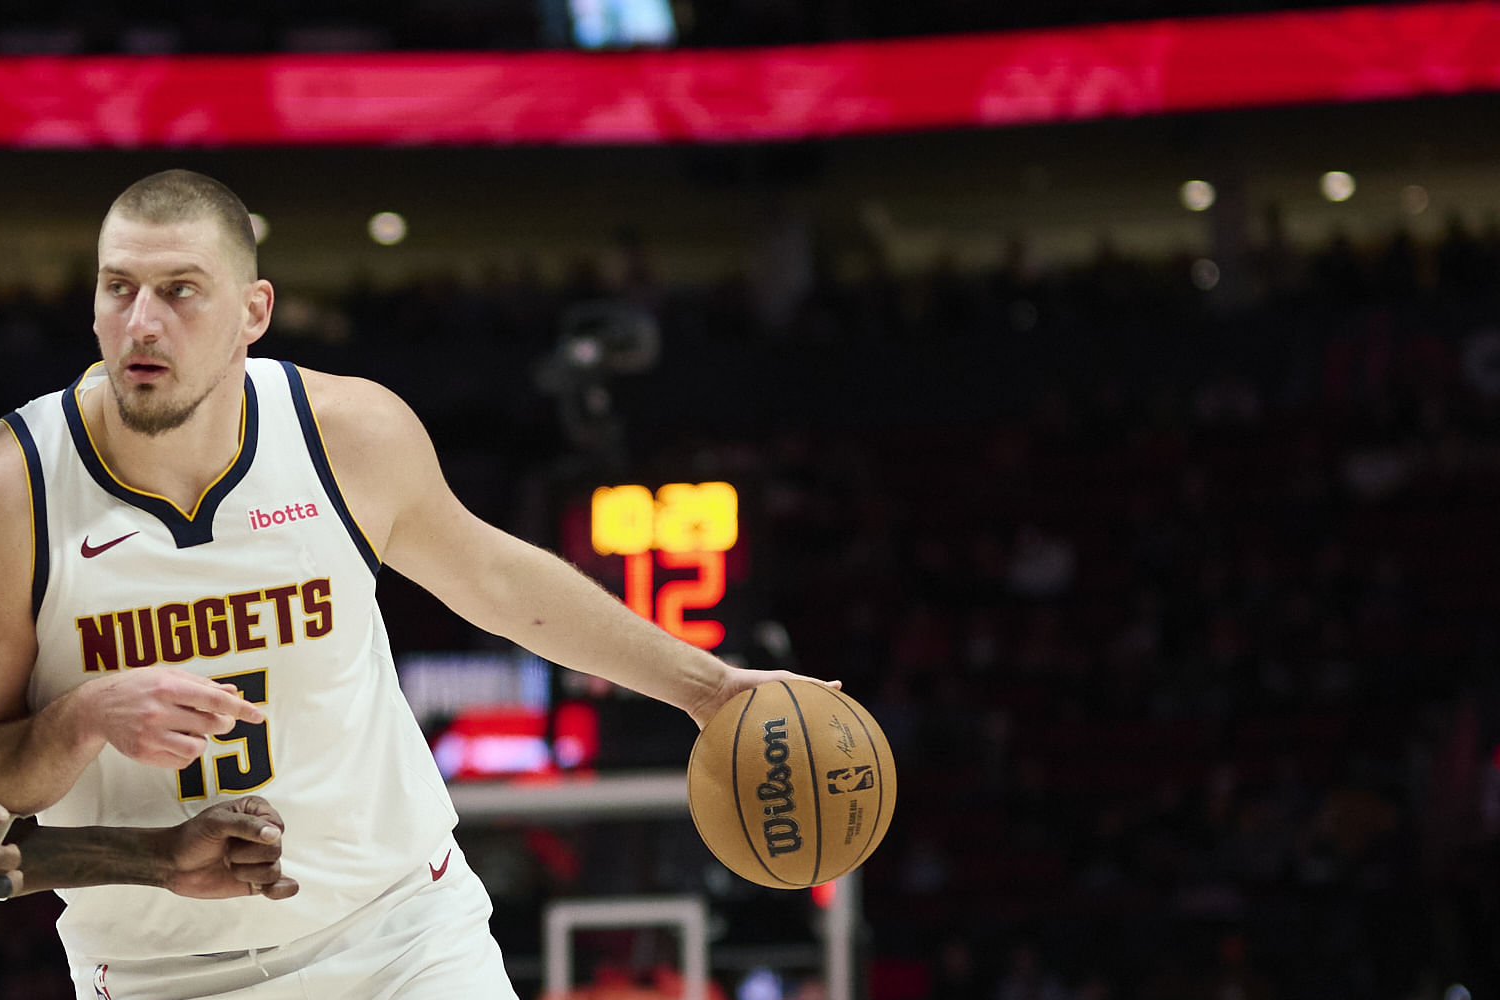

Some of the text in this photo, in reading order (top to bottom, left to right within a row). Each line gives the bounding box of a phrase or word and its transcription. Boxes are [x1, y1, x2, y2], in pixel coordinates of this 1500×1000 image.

[249, 502, 319, 530] ibotta
[75, 576, 333, 672] NUGGETS
[757, 717, 802, 857] Wilson
